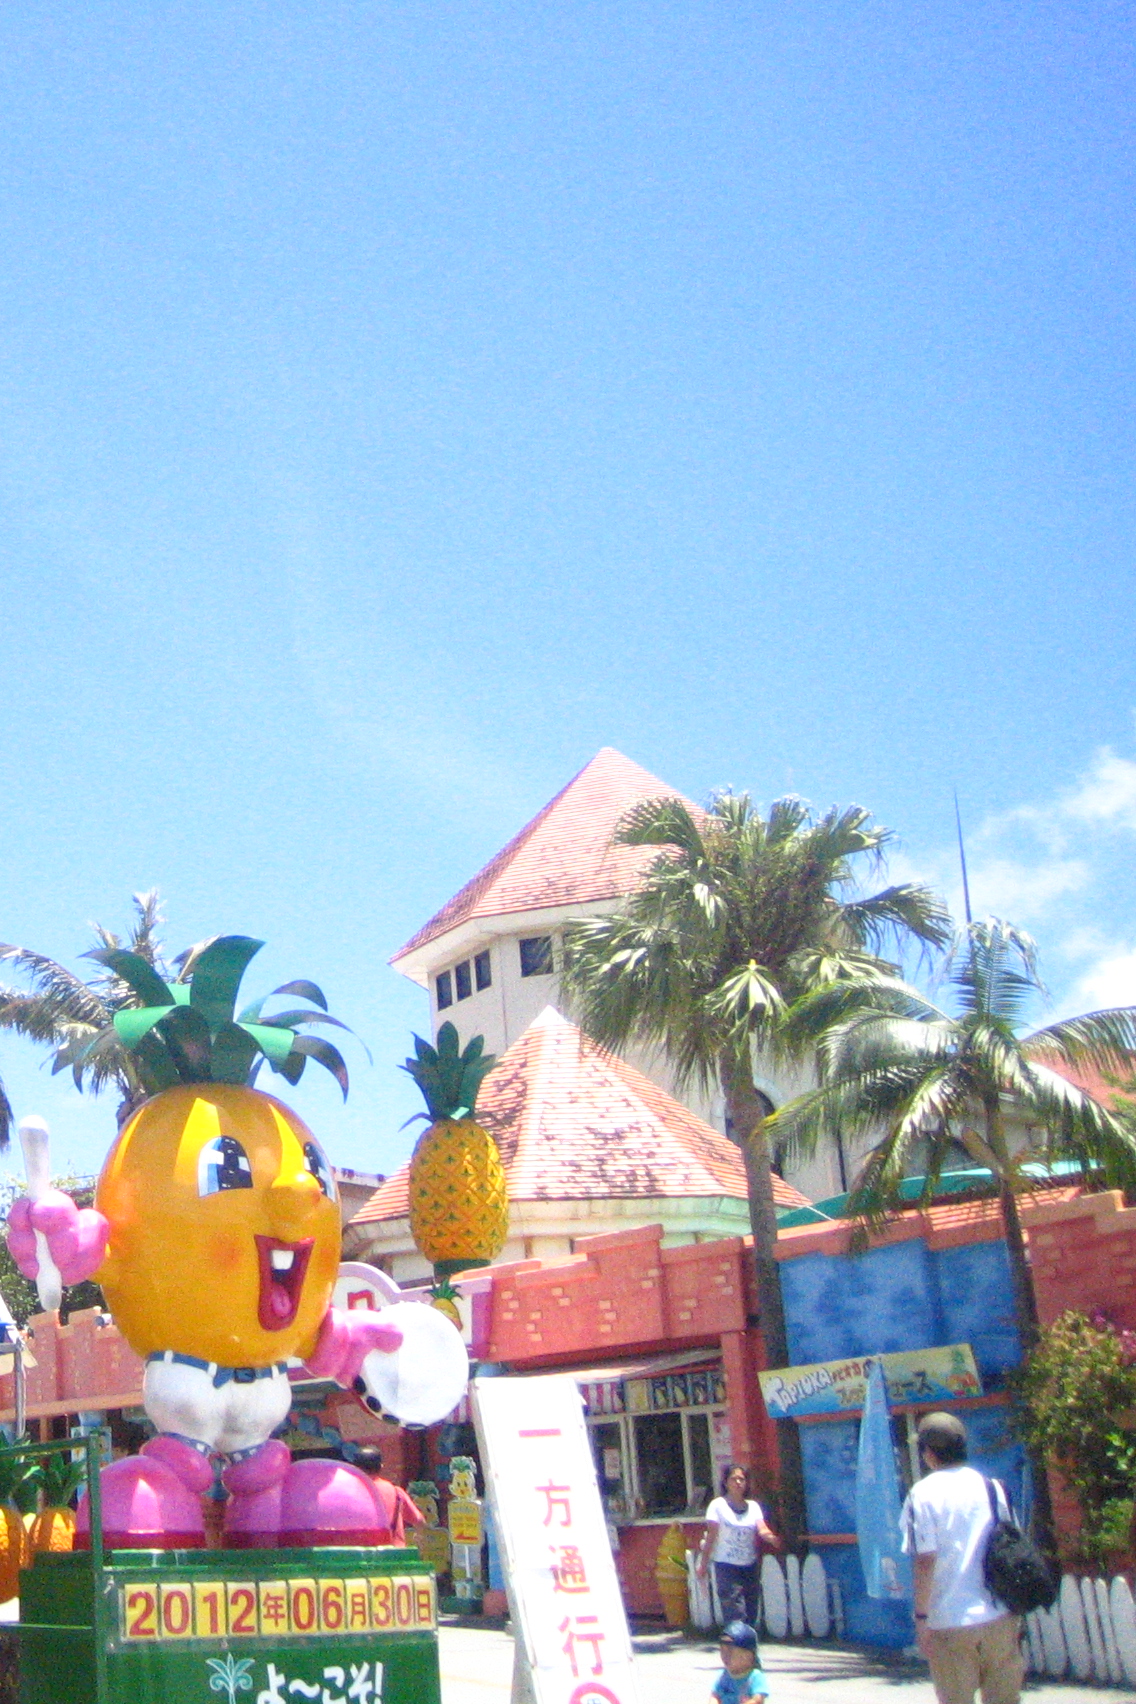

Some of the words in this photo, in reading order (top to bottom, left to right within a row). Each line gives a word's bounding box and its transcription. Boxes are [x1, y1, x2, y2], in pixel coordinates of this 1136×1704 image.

[127, 1584, 432, 1638] 2012年06月30日
[518, 1428, 606, 1678] 一方通行
